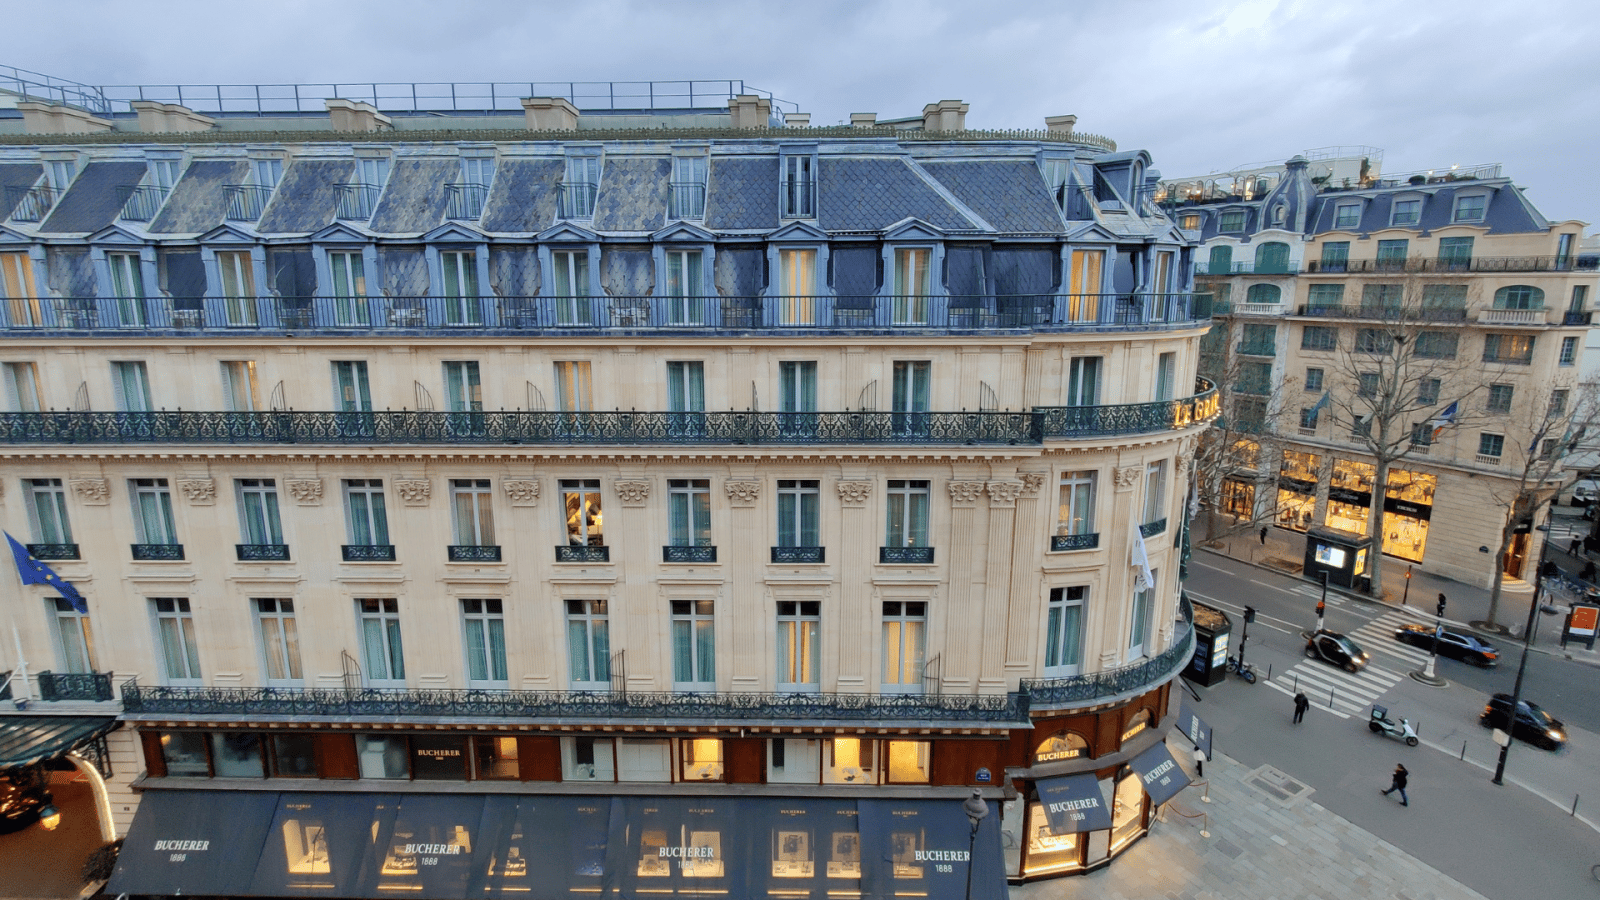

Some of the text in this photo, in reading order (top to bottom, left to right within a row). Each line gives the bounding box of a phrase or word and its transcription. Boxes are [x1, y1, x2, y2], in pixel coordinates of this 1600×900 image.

[417, 749, 460, 757] BUCHERER
[1037, 749, 1080, 762] BUCHERER
[1143, 759, 1175, 785] BUCHERER
[1049, 797, 1100, 814] BUCHERER
[1070, 812, 1086, 821] 1888
[154, 840, 210, 851] BUCHERER
[404, 843, 461, 855] BUCHERER
[169, 853, 187, 862] 1888
[658, 846, 715, 858] BUCHERER
[915, 850, 970, 862] BUCHERER
[421, 857, 439, 866] 1888
[935, 864, 953, 873] 1888
